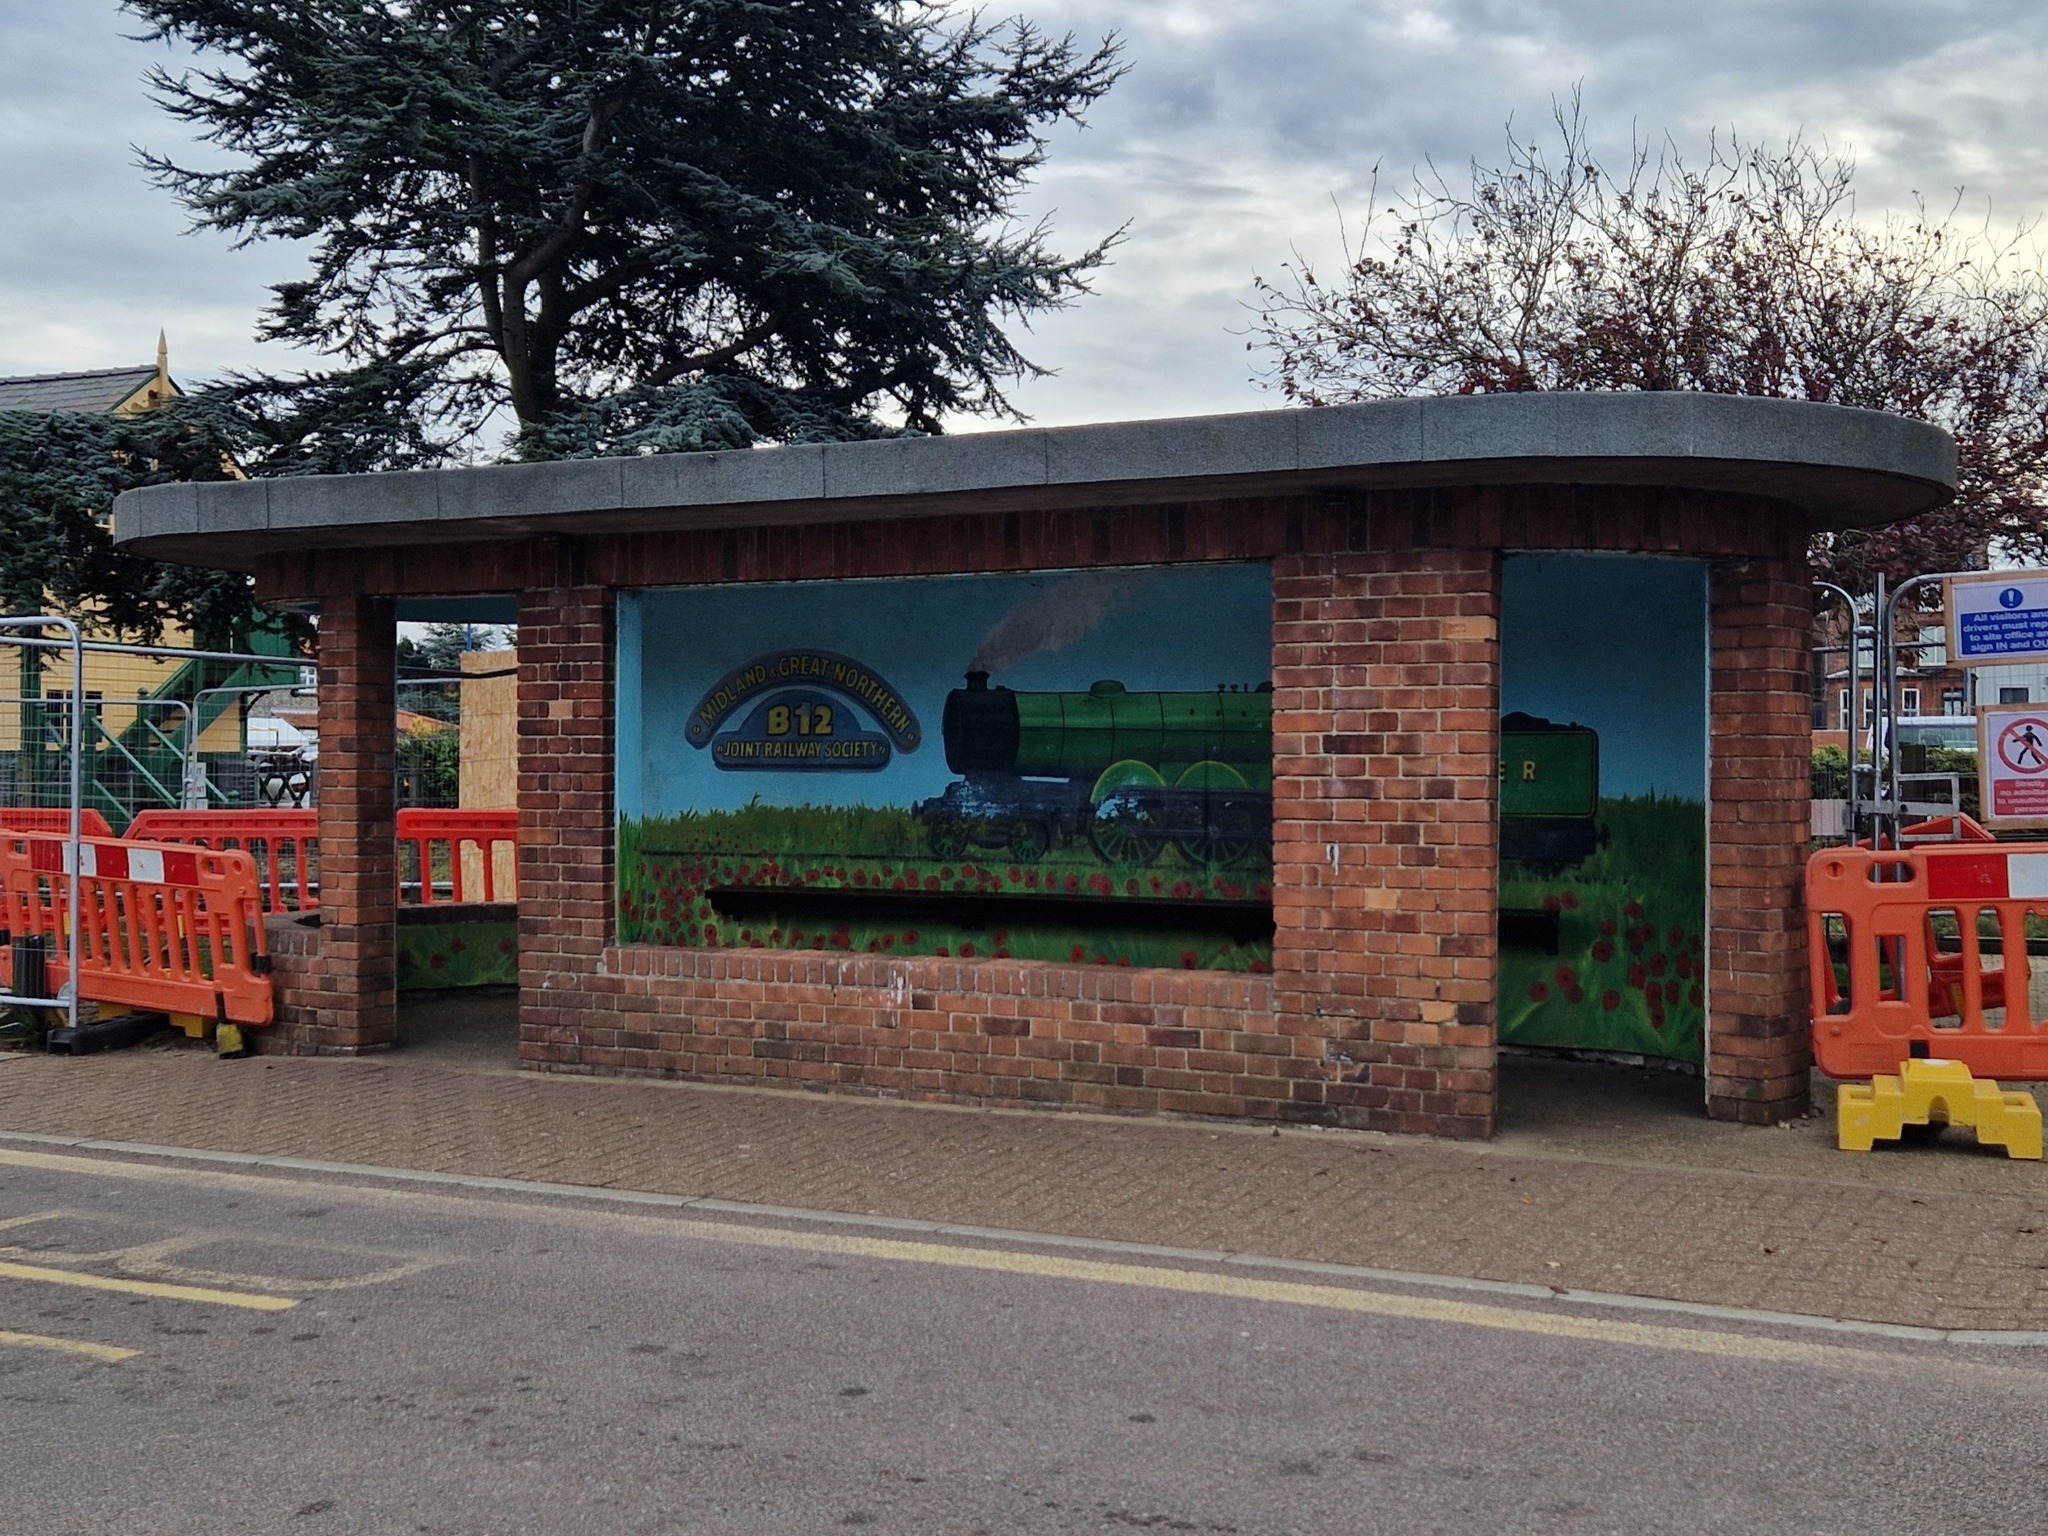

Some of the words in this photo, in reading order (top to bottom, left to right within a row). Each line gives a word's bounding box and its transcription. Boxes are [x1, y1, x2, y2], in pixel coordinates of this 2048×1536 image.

[1990, 612, 2028, 620] visitors
[1983, 632, 2002, 641] site
[2004, 631, 2034, 639] office
[1970, 643, 1993, 652] sign
[1996, 642, 2008, 650] IN
[2010, 640, 2029, 648] and
[700, 665, 767, 725] MIDLAND
[780, 656, 830, 676] GREAT
[833, 662, 911, 734] NORTHERN
[765, 742, 822, 757] RAILWAY
